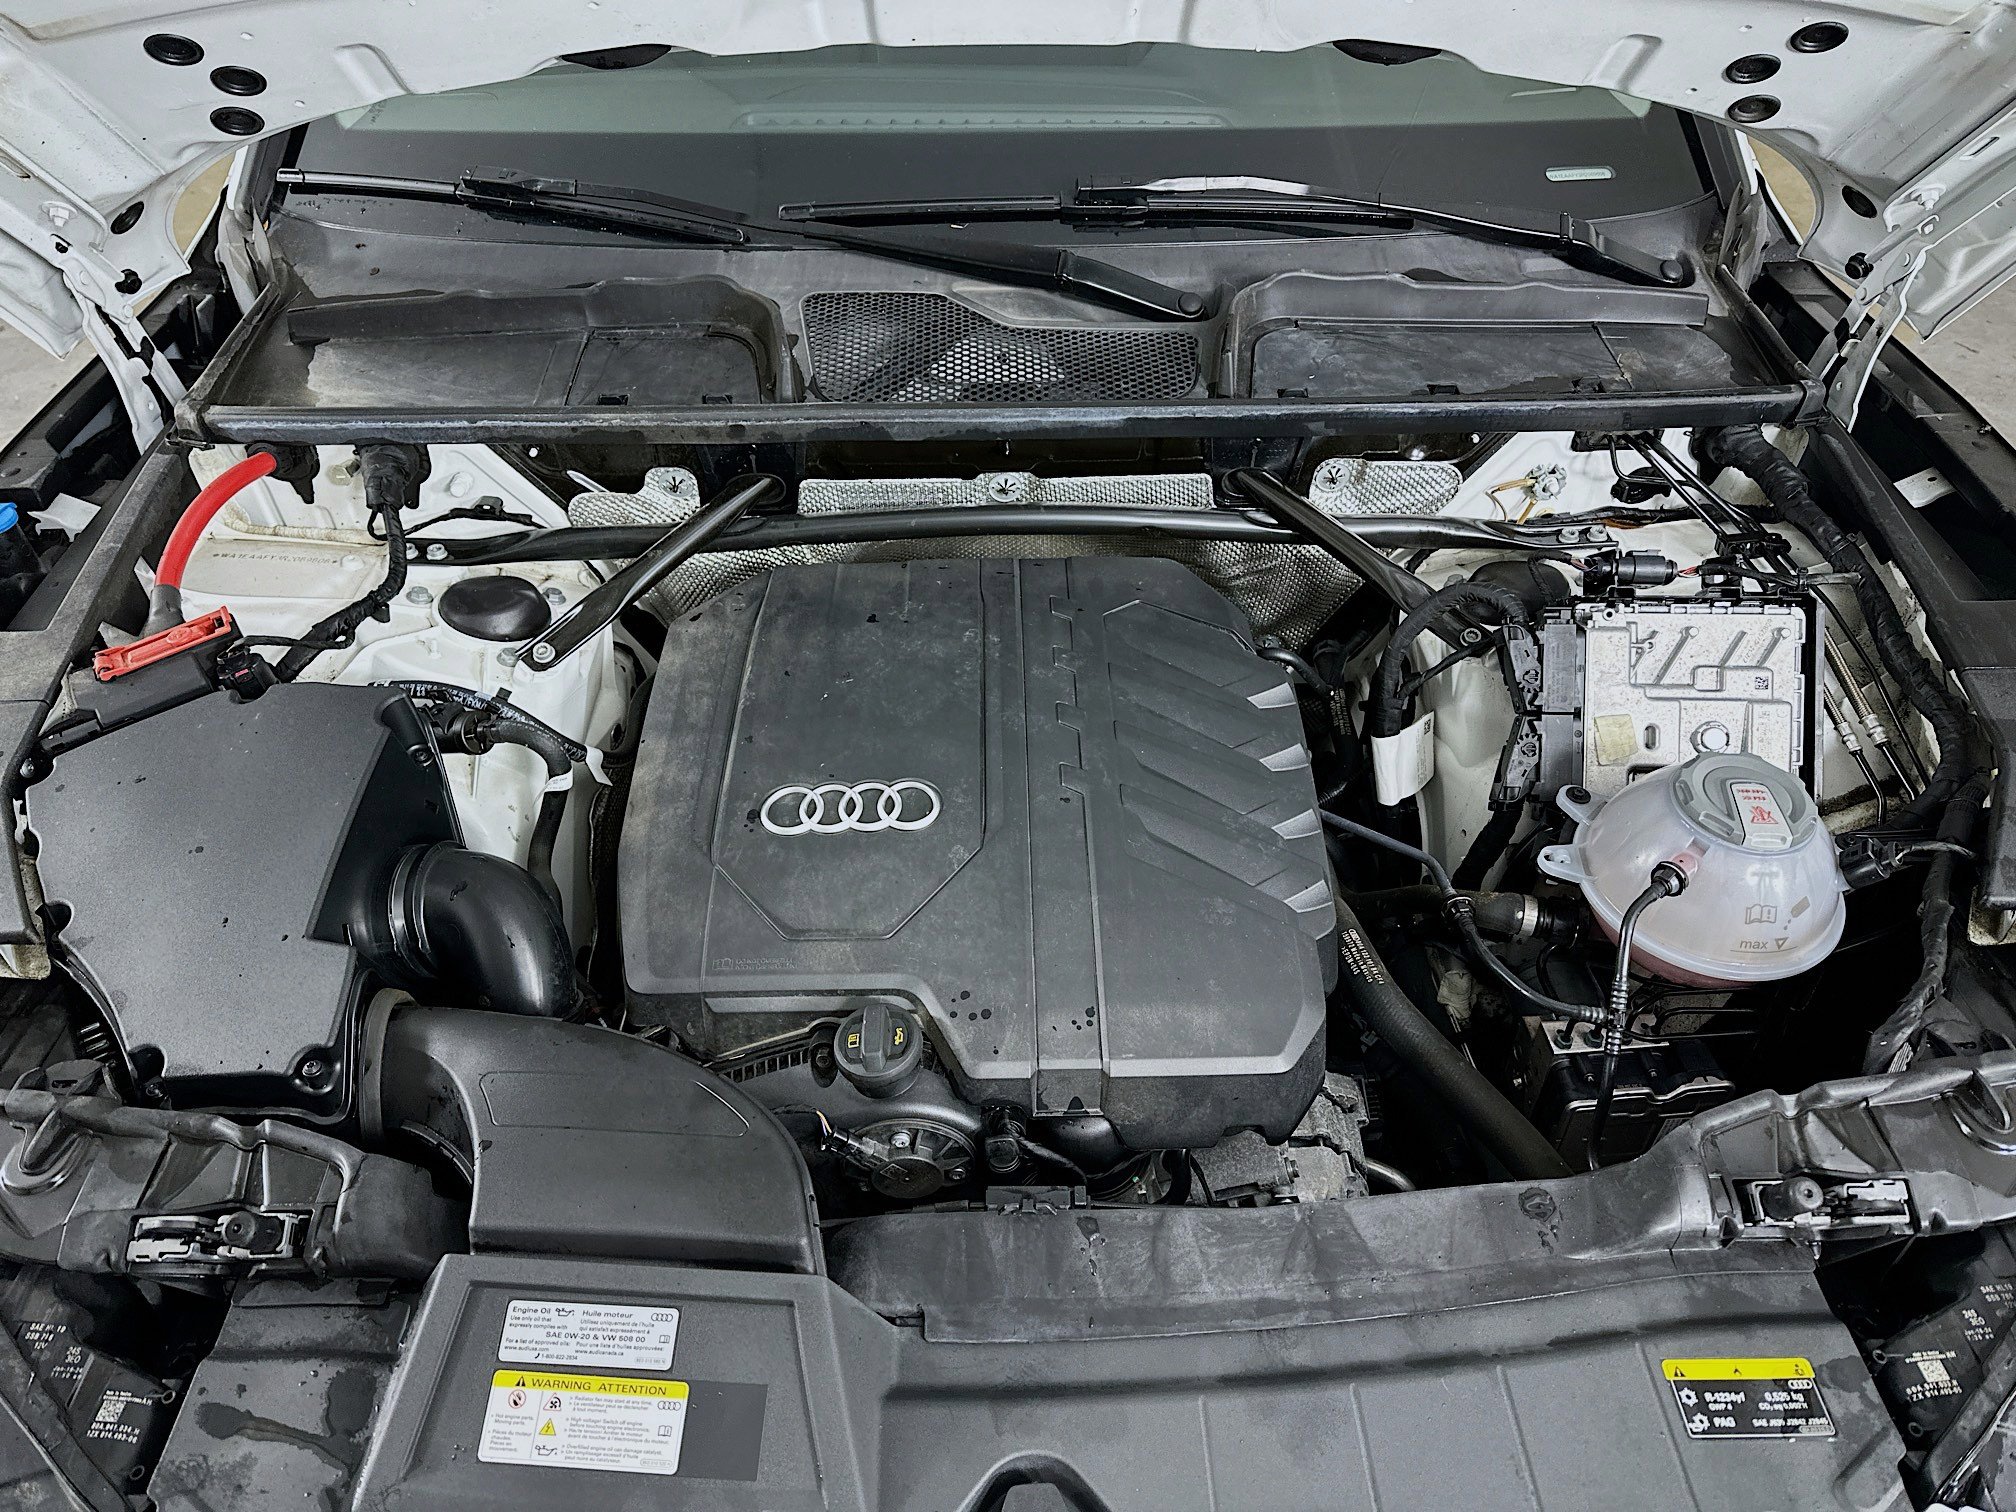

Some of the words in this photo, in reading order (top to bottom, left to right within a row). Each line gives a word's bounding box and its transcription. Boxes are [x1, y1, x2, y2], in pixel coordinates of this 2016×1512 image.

[1739, 940, 1769, 950] max
[512, 1306, 538, 1314] Engine
[603, 1311, 634, 1319] moteur
[30, 1322, 45, 1331] SAE
[531, 1378, 591, 1391] WARNING
[597, 1383, 667, 1396] ATTENTION
[1790, 1391, 1805, 1402] kg
[1708, 1402, 1727, 1411] GWP
[1727, 1402, 1733, 1410] 4
[1713, 1416, 1737, 1428] PAG
